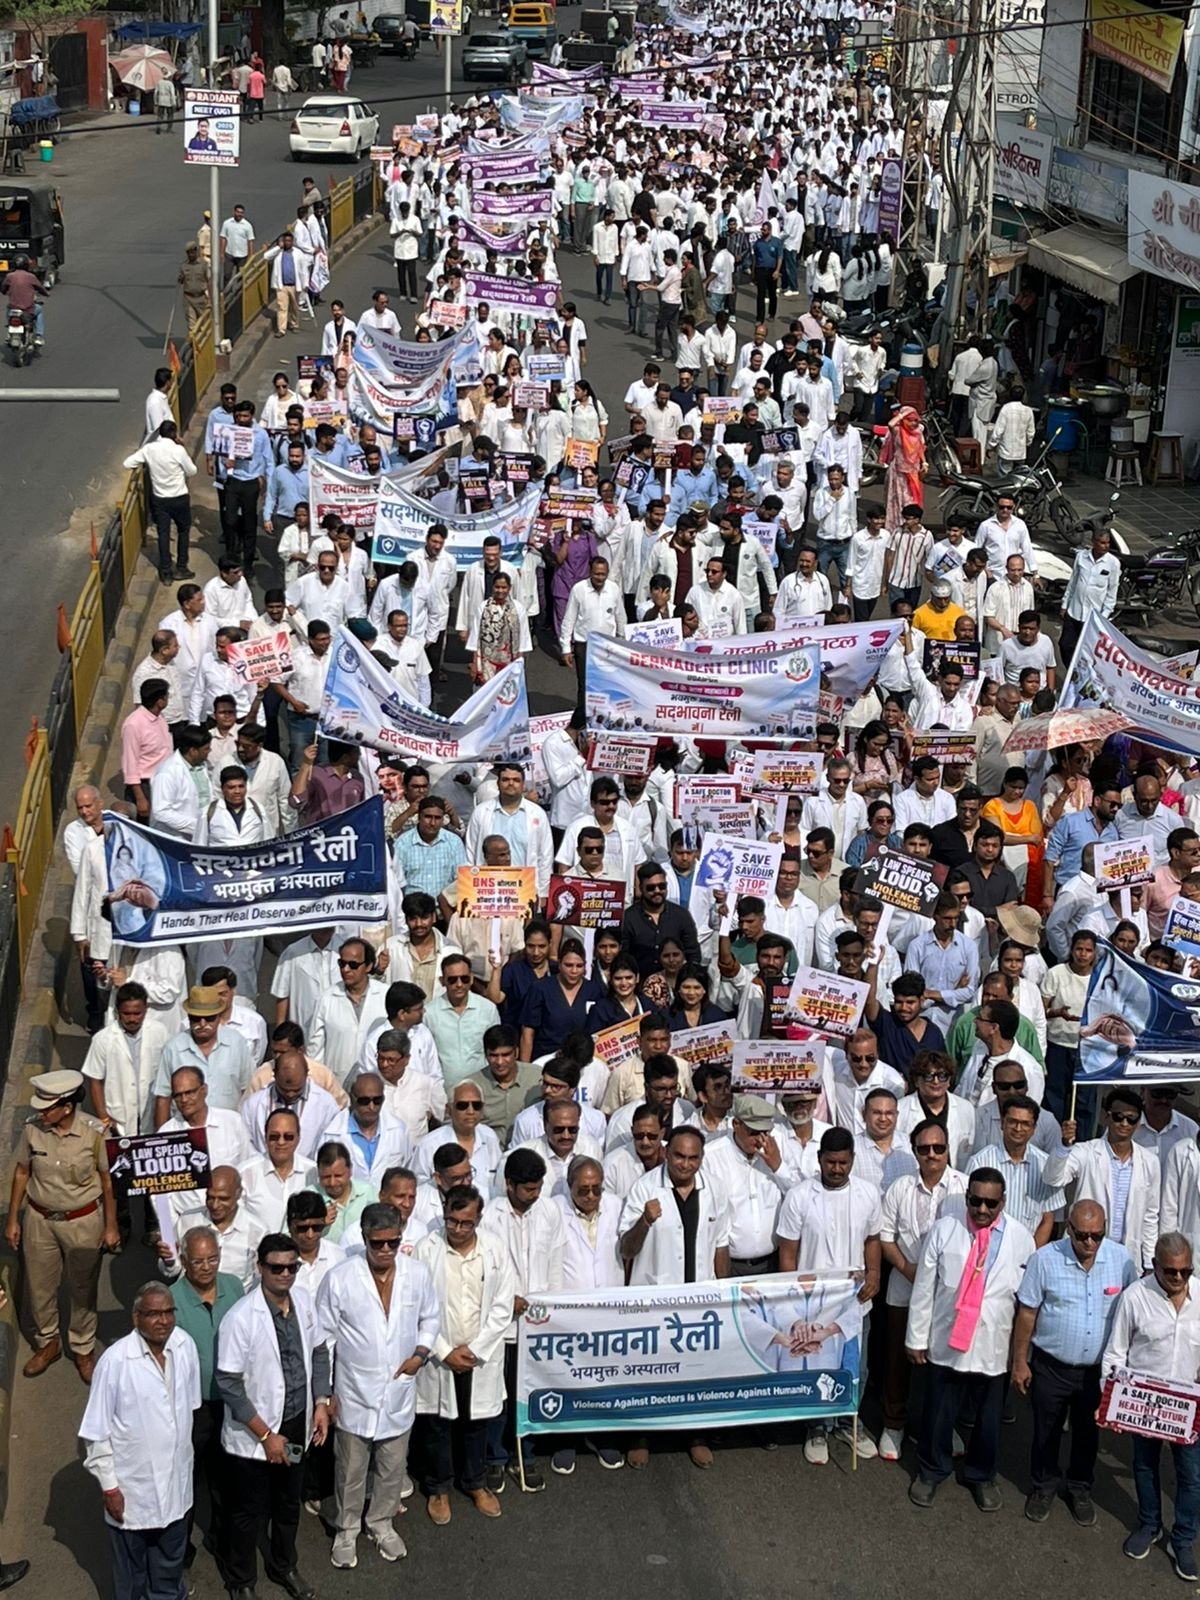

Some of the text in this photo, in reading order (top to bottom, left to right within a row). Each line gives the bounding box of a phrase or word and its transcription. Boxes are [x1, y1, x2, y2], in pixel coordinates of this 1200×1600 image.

[197, 92, 239, 103] RADIANT
[193, 106, 212, 114] NEET
[465, 273, 512, 286] GEETANJALI
[654, 626, 675, 637] SAVE
[245, 643, 273, 656] SAVE
[629, 653, 779, 675] DERMADENT CLINIC
[1094, 631, 1188, 697] सद्भावना
[656, 705, 742, 722] सद्भावना रैली
[379, 726, 460, 758] सद्भावना रैली
[719, 820, 751, 829] अस्पताल
[191, 825, 359, 878] सद्भावना रैली
[742, 852, 772, 865] SAVE
[734, 865, 775, 878] SAVIOUR
[883, 857, 902, 872] LAW
[901, 864, 932, 882] SPEAKS
[213, 871, 346, 901] भयमुक्त अस्पताल
[473, 877, 495, 887] BNS
[738, 878, 766, 889] STOP
[865, 887, 922, 912] NOT ALLOWED!
[872, 882, 920, 905] VIOLENCE
[161, 914, 196, 929] Hands
[199, 912, 223, 927] That
[224, 910, 249, 923] Heal
[252, 906, 296, 921] Deserve
[298, 902, 335, 916] Safety,
[337, 899, 356, 912] Not
[596, 1037, 619, 1053] BNS
[751, 1070, 810, 1080] सम्मान
[132, 1142, 192, 1160] LAW SPEAKS
[134, 1155, 192, 1176] LOUD.
[127, 1181, 198, 1196] NOT ALLOWED!
[132, 1172, 193, 1188] VIOLENCE
[553, 1292, 722, 1310] INDIAN MEDICAL ASSOCIATION
[526, 1310, 723, 1366] सद्भावना रैली
[570, 1362, 681, 1383] भयमुक्त अस्पताल
[572, 1384, 814, 1410] Violence Against Doctors Is Violence Against Humanity.
[1121, 1387, 1191, 1411] A SAFE DOCTOR
[1118, 1400, 1189, 1424] HEALTHY FUTURE
[1115, 1412, 1186, 1436] HEALTHY NATION
